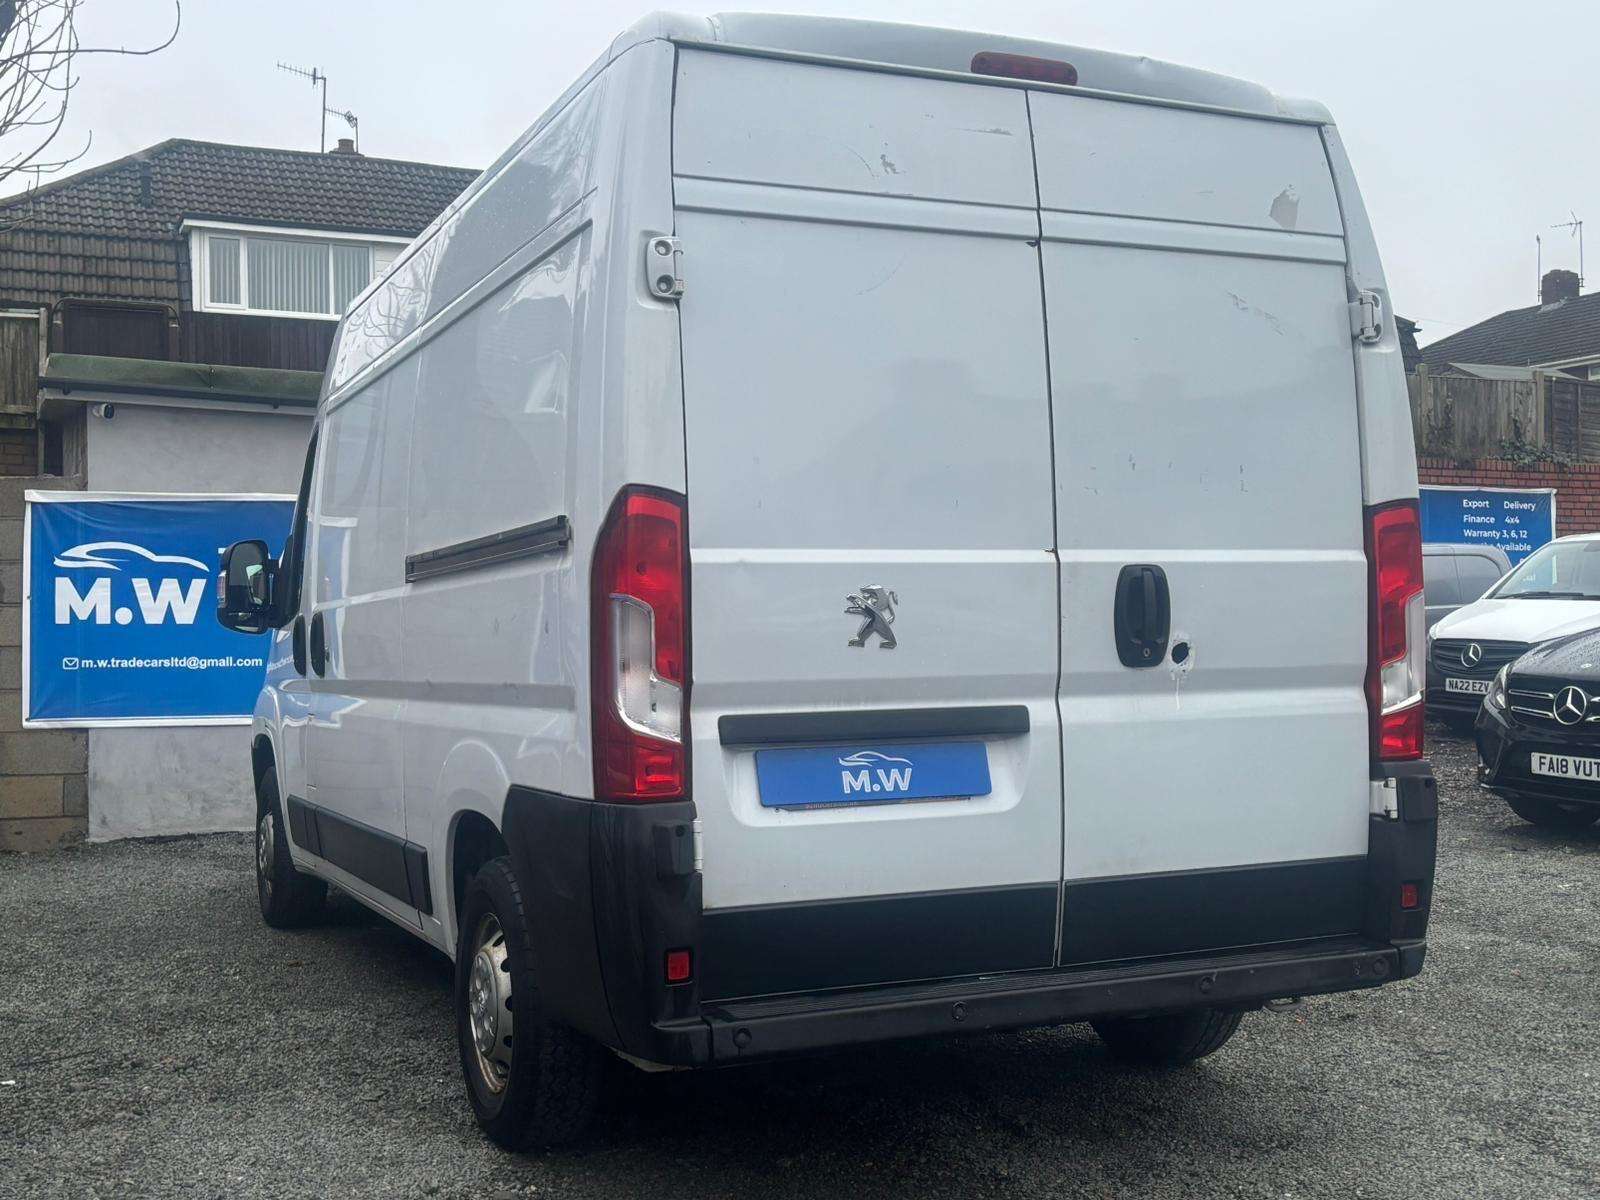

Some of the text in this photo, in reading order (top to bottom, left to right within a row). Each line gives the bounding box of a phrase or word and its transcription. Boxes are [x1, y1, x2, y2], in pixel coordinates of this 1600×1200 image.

[1463, 499, 1490, 509] Export
[1504, 501, 1536, 511] Delivery
[1463, 514, 1496, 524] Finance
[1505, 516, 1520, 524] 4x4
[1463, 529, 1528, 539] Warranty 3, 6, 12
[55, 577, 207, 625] M.W
[81, 655, 263, 669] m.w.tradecarsltd@gmail.com
[1448, 680, 1470, 691] NA22
[841, 767, 913, 794] M.W
